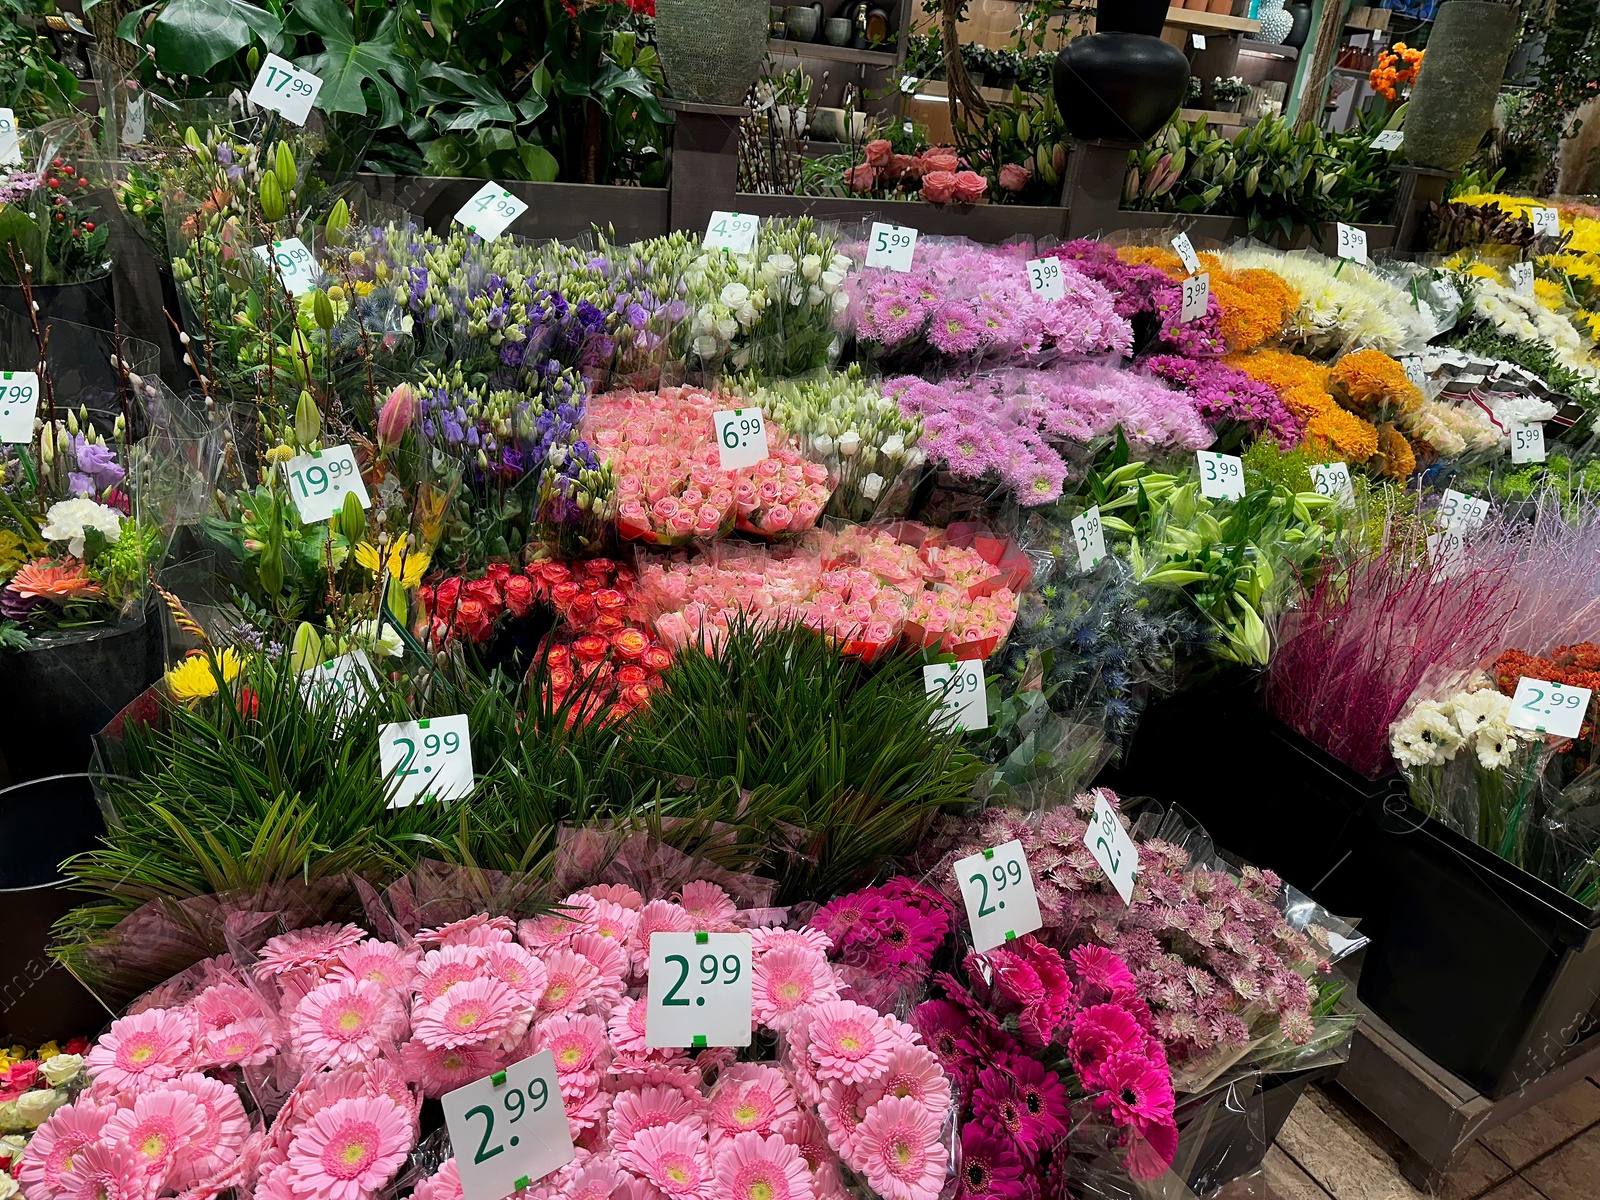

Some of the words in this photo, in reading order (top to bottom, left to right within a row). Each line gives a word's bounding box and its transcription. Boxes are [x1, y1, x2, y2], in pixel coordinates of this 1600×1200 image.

[265, 66, 313, 99] 17.99
[1378, 134, 1402, 143] 2.99
[475, 194, 516, 218] 499
[712, 219, 752, 239] 4.99
[1536, 213, 1555, 226] 2.99
[876, 232, 909, 255] 5.99
[1342, 235, 1363, 248] 3.99
[1033, 265, 1058, 289] 3.99
[1518, 267, 1531, 286] 5.99
[1186, 282, 1206, 307] 3.99
[721, 418, 760, 449] 6.99
[1517, 429, 1539, 449] 5.99
[289, 459, 353, 498] 19.99
[1202, 459, 1238, 482] 3.99
[1443, 498, 1481, 521] 3.99
[1077, 516, 1098, 552] 3.99
[1432, 536, 1459, 562] .99
[1522, 688, 1581, 715] 2.99
[391, 731, 460, 777] 2.99
[1097, 809, 1117, 874] 2.99
[969, 859, 1021, 917] 2.99
[661, 954, 741, 1007] 2.99
[464, 1076, 550, 1166] 2.99
